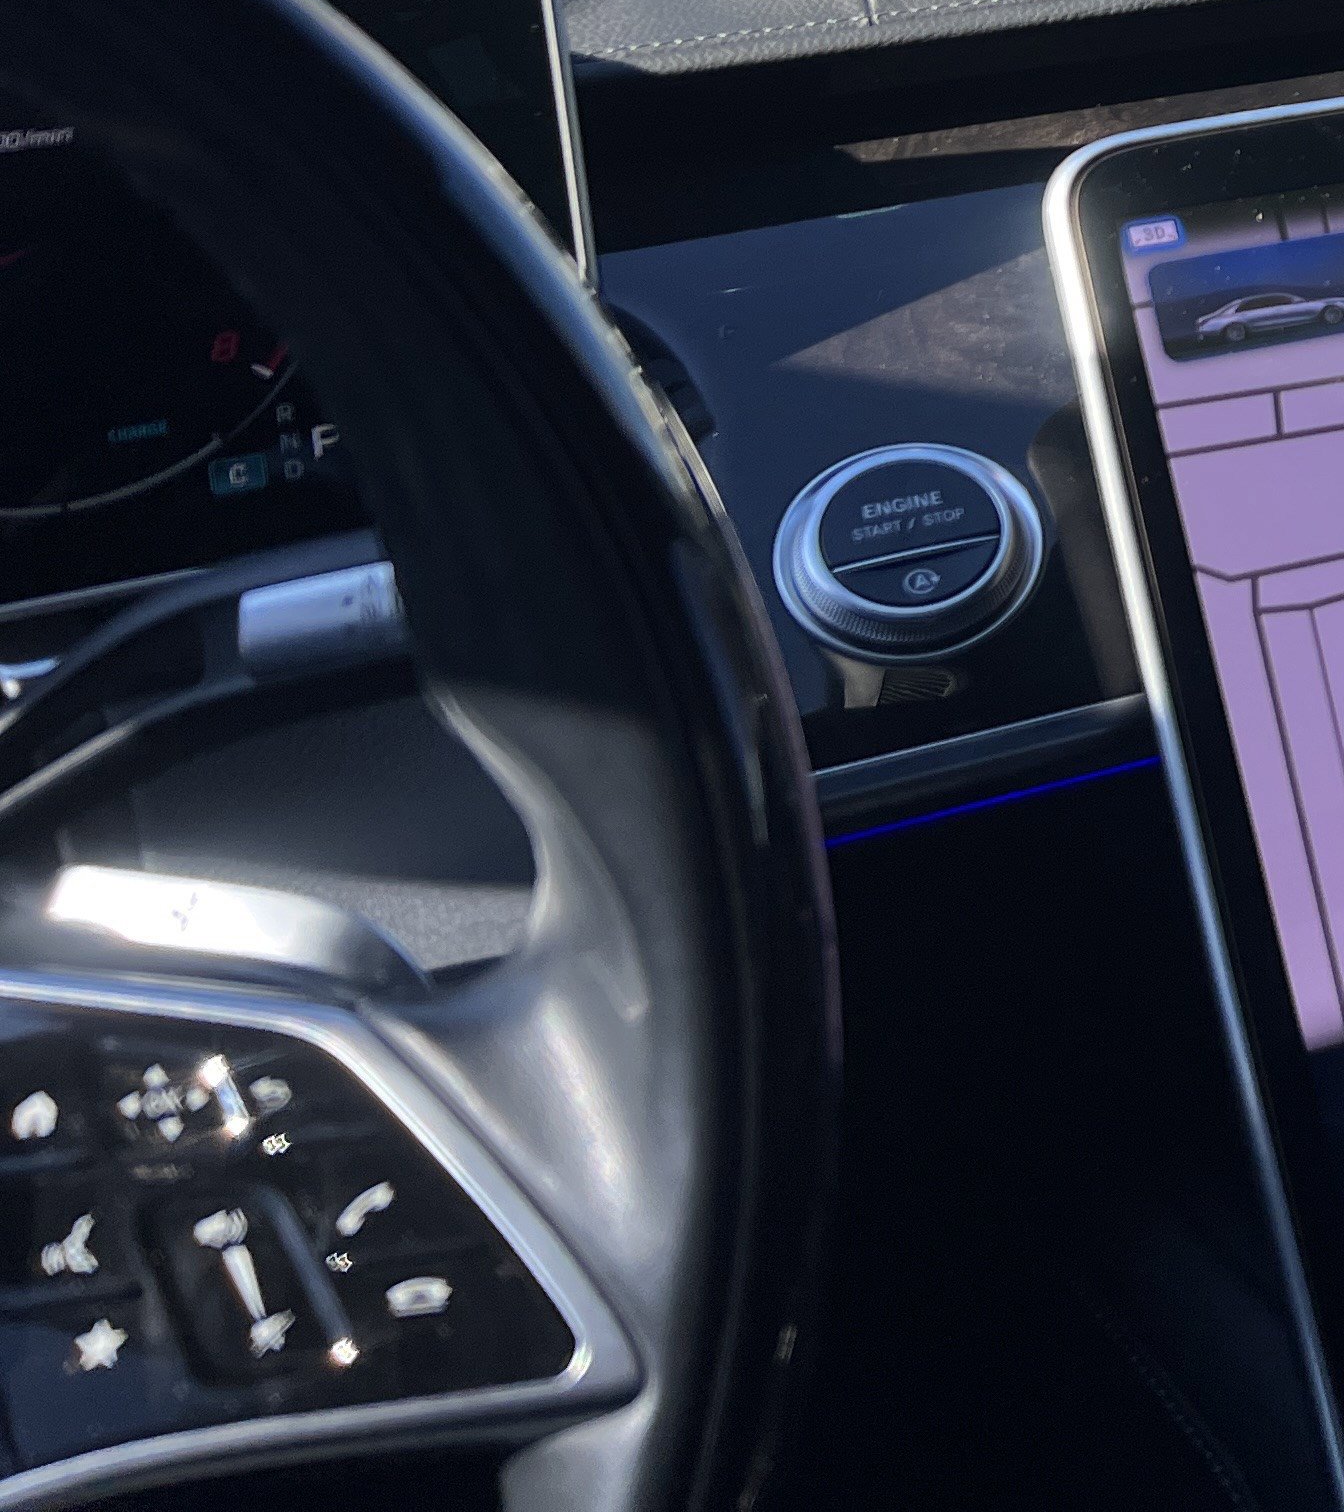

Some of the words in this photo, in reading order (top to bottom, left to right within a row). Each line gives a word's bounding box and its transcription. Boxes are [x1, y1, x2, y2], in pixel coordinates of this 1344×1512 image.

[862, 490, 943, 520] ENGINE
[852, 520, 901, 541] START
[922, 508, 965, 526] STOP
